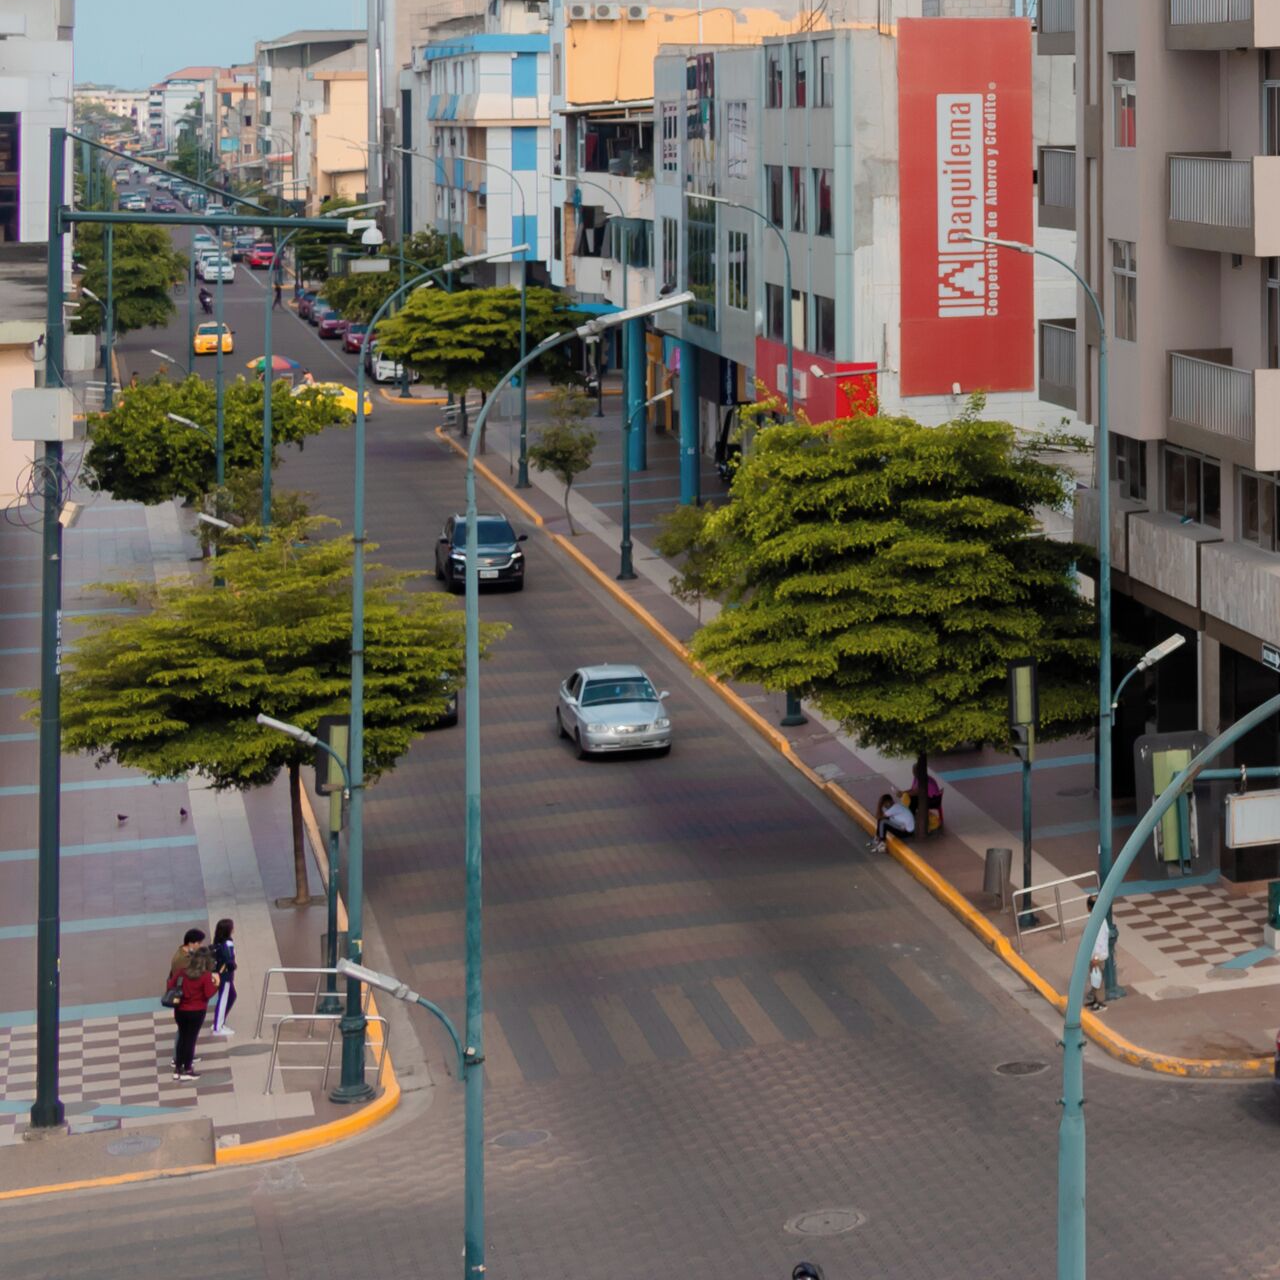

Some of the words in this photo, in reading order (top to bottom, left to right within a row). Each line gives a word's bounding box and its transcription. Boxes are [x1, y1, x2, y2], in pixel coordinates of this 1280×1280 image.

[983, 92, 998, 145] Crédito
[942, 101, 978, 244] Daquilema
[986, 146, 999, 157] y
[985, 159, 998, 206] Ahorro
[985, 211, 998, 228] de
